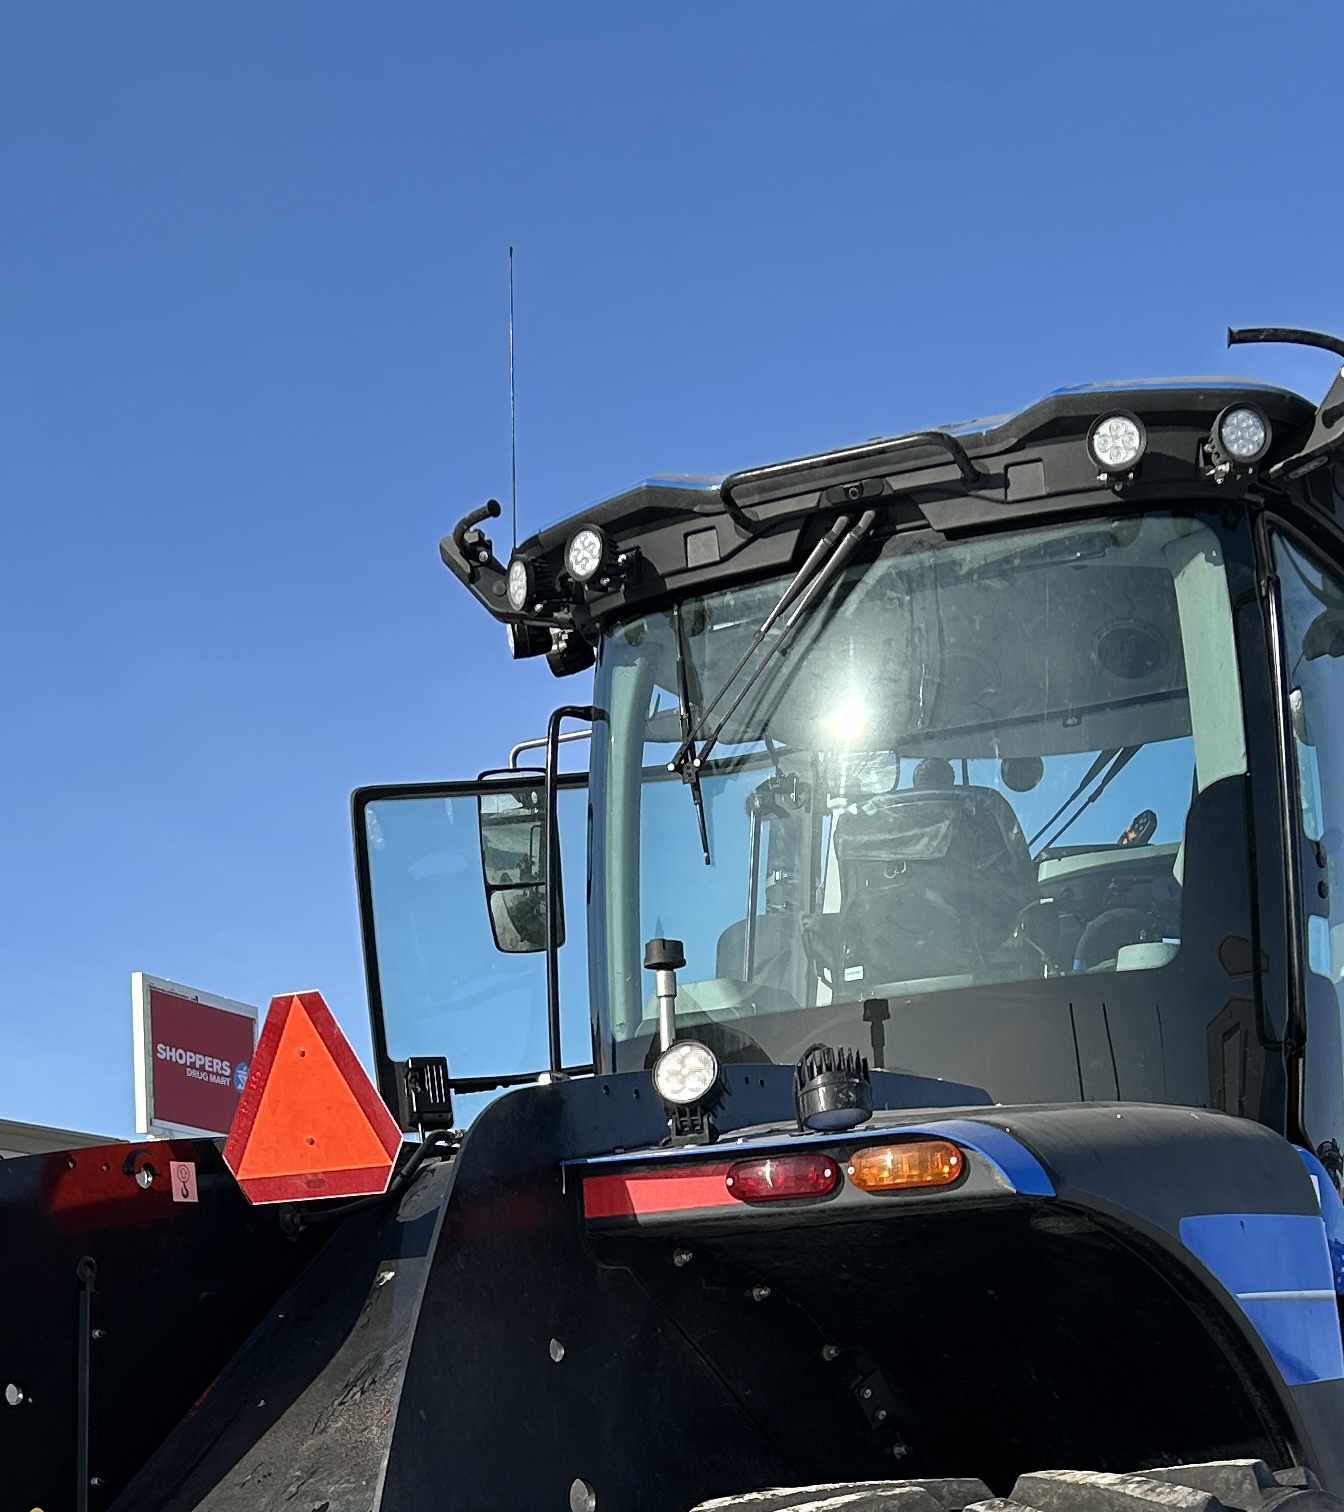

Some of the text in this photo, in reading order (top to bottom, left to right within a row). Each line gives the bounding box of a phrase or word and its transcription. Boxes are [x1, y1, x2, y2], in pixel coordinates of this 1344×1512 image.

[156, 1043, 231, 1075] SHOPPERS
[186, 1067, 231, 1086] DRUG MART
